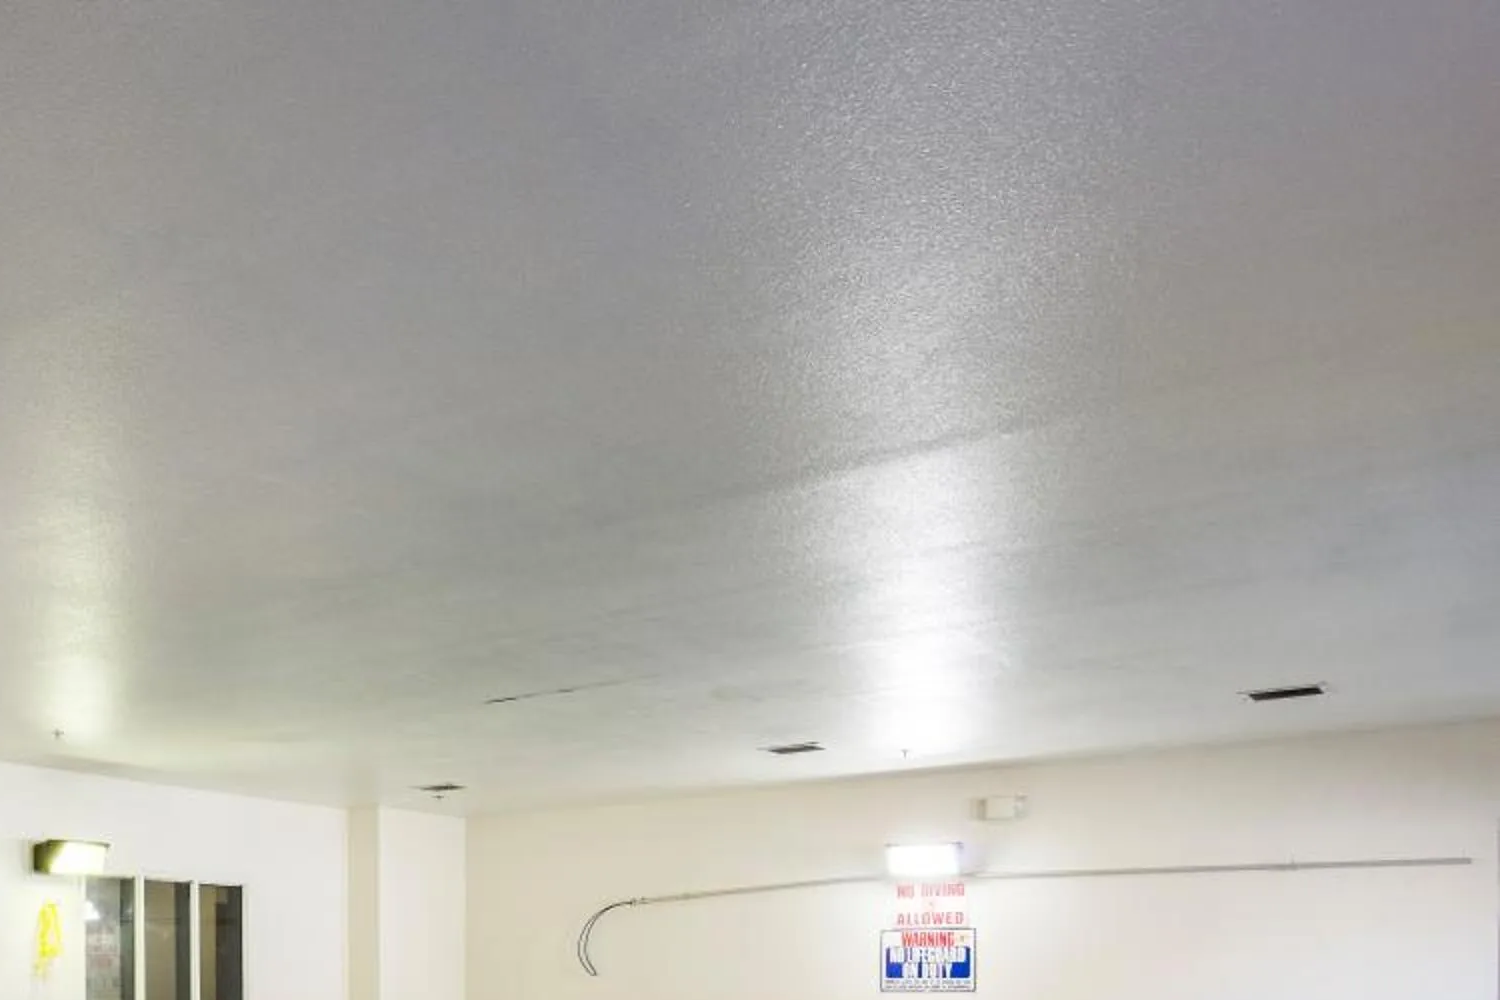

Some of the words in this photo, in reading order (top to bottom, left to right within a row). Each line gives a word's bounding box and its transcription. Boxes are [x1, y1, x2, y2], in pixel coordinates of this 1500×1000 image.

[921, 883, 965, 897] DIVING
[897, 911, 964, 924] ALLOWED
[902, 931, 955, 947] WARNING
